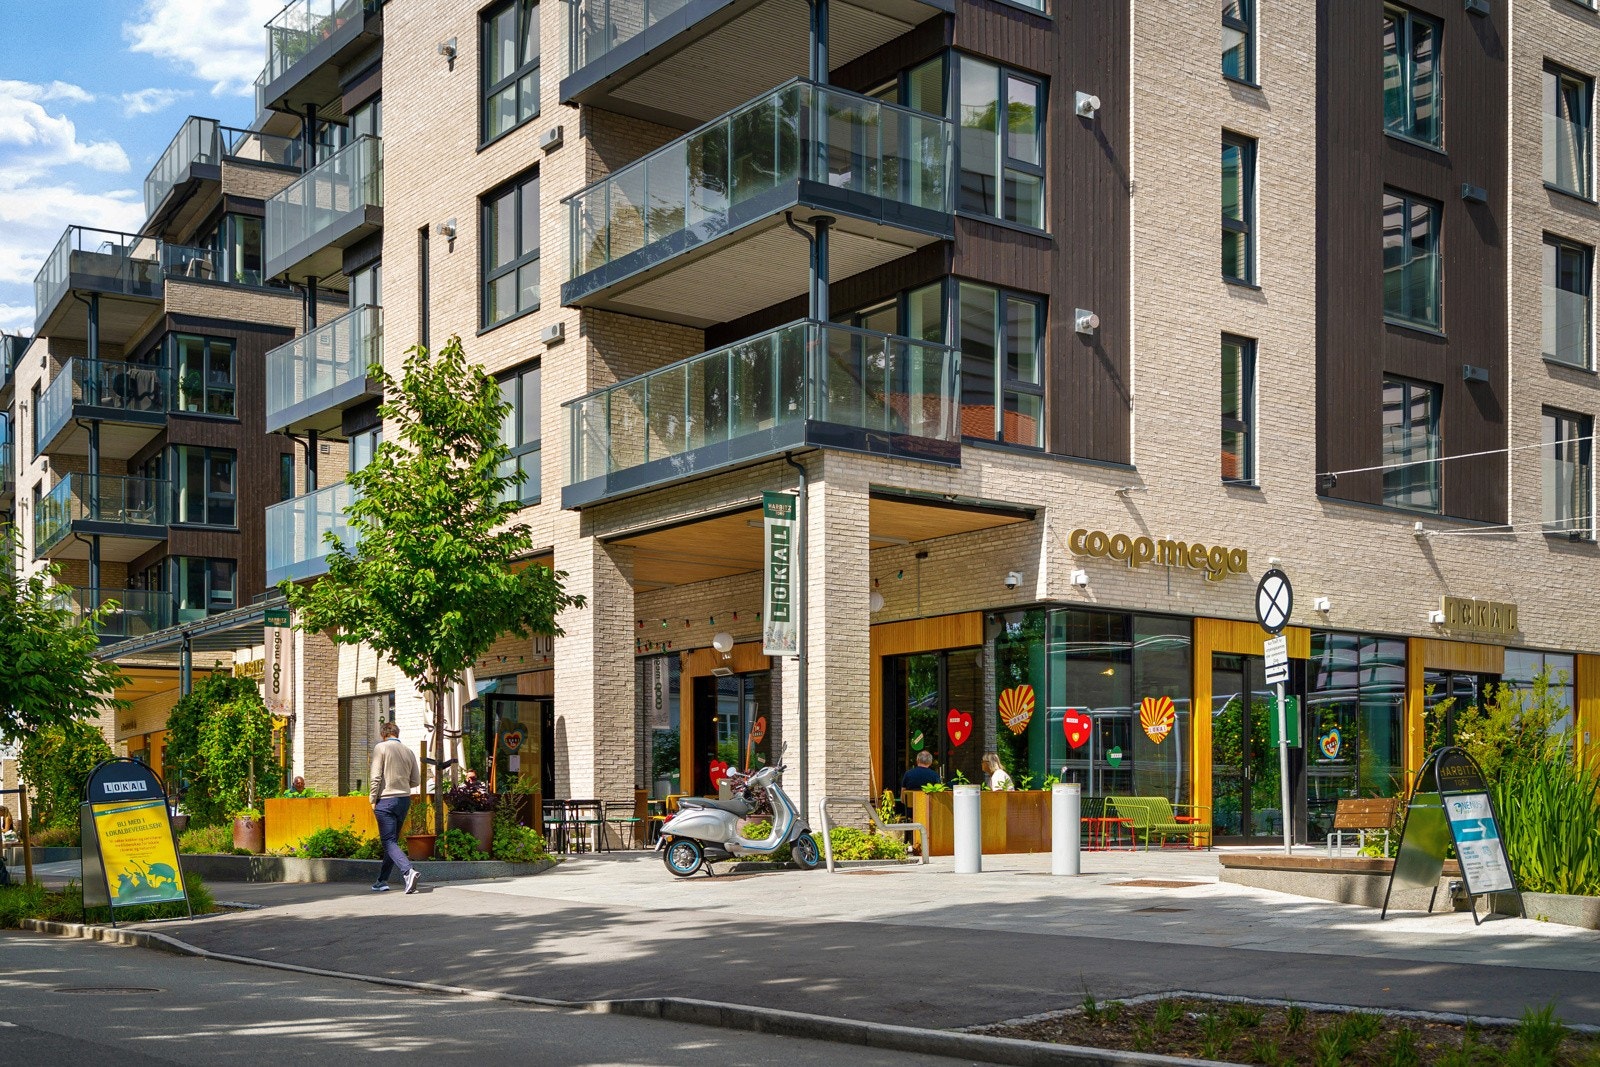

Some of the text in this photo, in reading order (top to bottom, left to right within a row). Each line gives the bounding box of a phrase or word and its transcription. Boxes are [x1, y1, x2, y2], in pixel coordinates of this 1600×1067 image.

[1067, 528, 1248, 582] coop mega
[774, 530, 787, 616] LOKAL
[1449, 602, 1514, 629] LOKAL
[274, 631, 282, 659] mega
[273, 662, 281, 694] coop
[1009, 712, 1028, 726] LOKAL
[1149, 725, 1167, 733] LOKAL
[1440, 765, 1477, 777] HARBITZ
[106, 783, 145, 791] LOKAL
